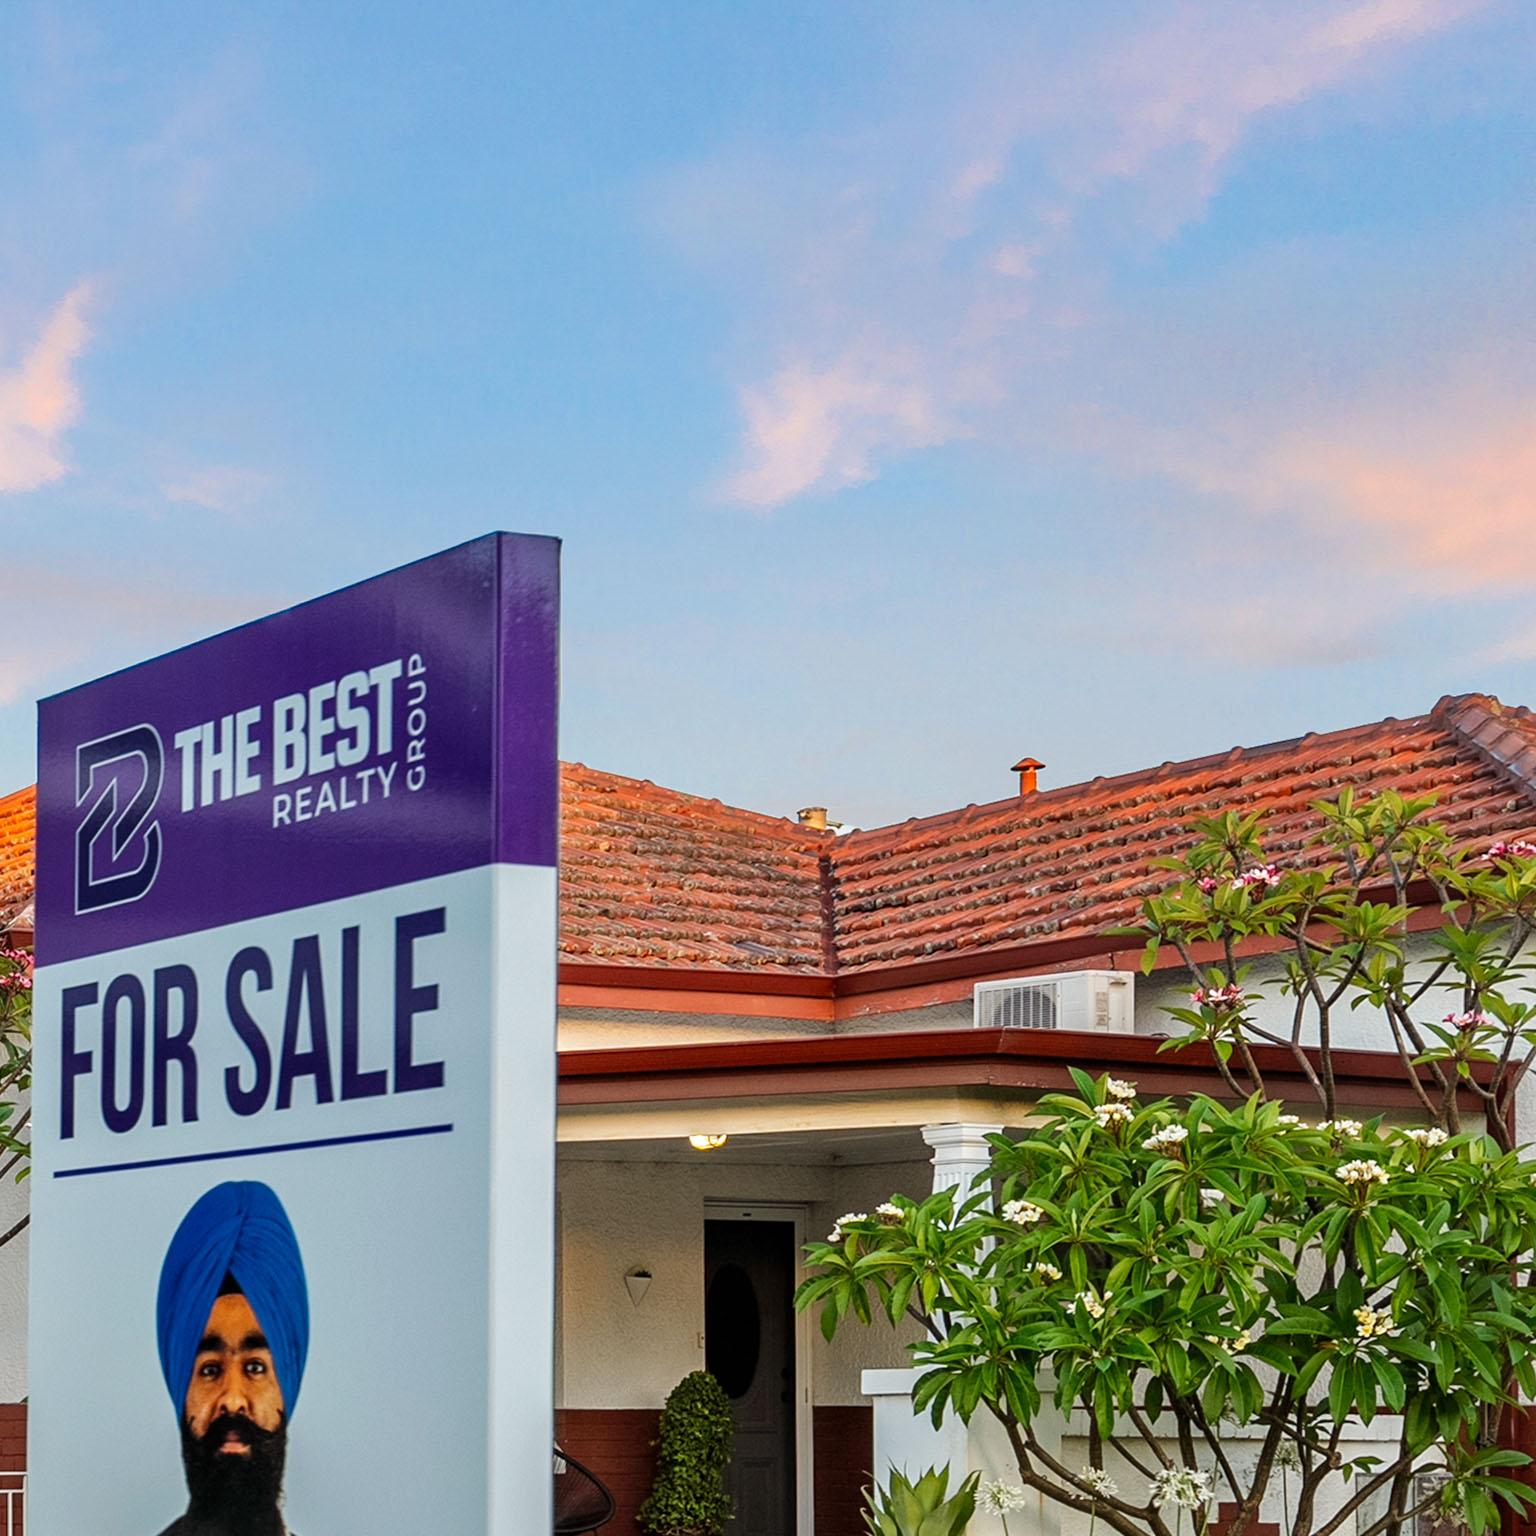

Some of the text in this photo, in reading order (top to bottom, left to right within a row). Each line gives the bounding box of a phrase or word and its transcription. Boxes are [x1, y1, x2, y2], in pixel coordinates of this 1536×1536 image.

[174, 659, 402, 813] THE BEST
[272, 761, 398, 829] REALTY
[406, 652, 428, 792] GROUP
[59, 905, 447, 1140] FOR SALE
